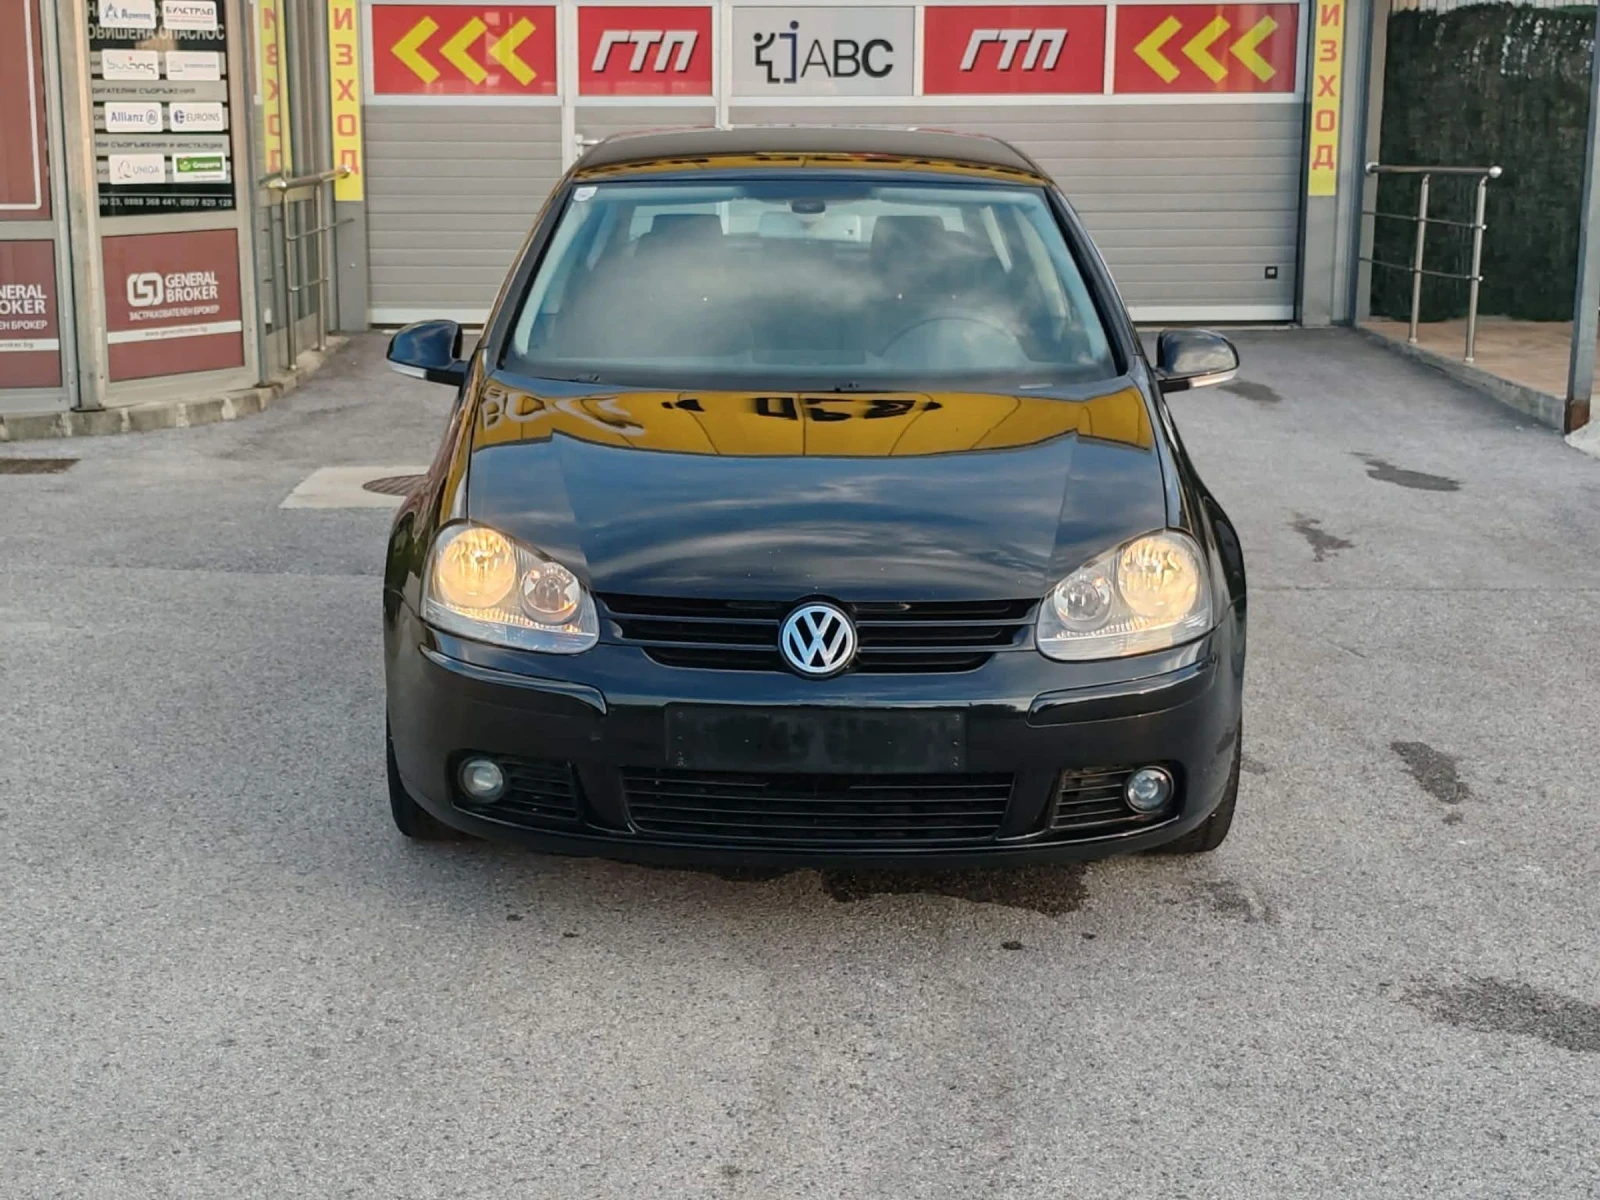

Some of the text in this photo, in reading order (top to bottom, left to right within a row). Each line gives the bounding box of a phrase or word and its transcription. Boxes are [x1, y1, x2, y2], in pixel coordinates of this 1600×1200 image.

[591, 29, 699, 73] ГТП
[959, 28, 1068, 72] ГТП
[333, 7, 360, 176] ИЗХОД
[1312, 4, 1341, 171] ИЗХОД
[110, 112, 145, 122] Allianz
[186, 113, 220, 122] EUROINS
[132, 164, 160, 175] UNIQA
[165, 271, 219, 288] GENERAL
[166, 285, 218, 303] BROKER
[11, 320, 48, 330] БРОКЕР
